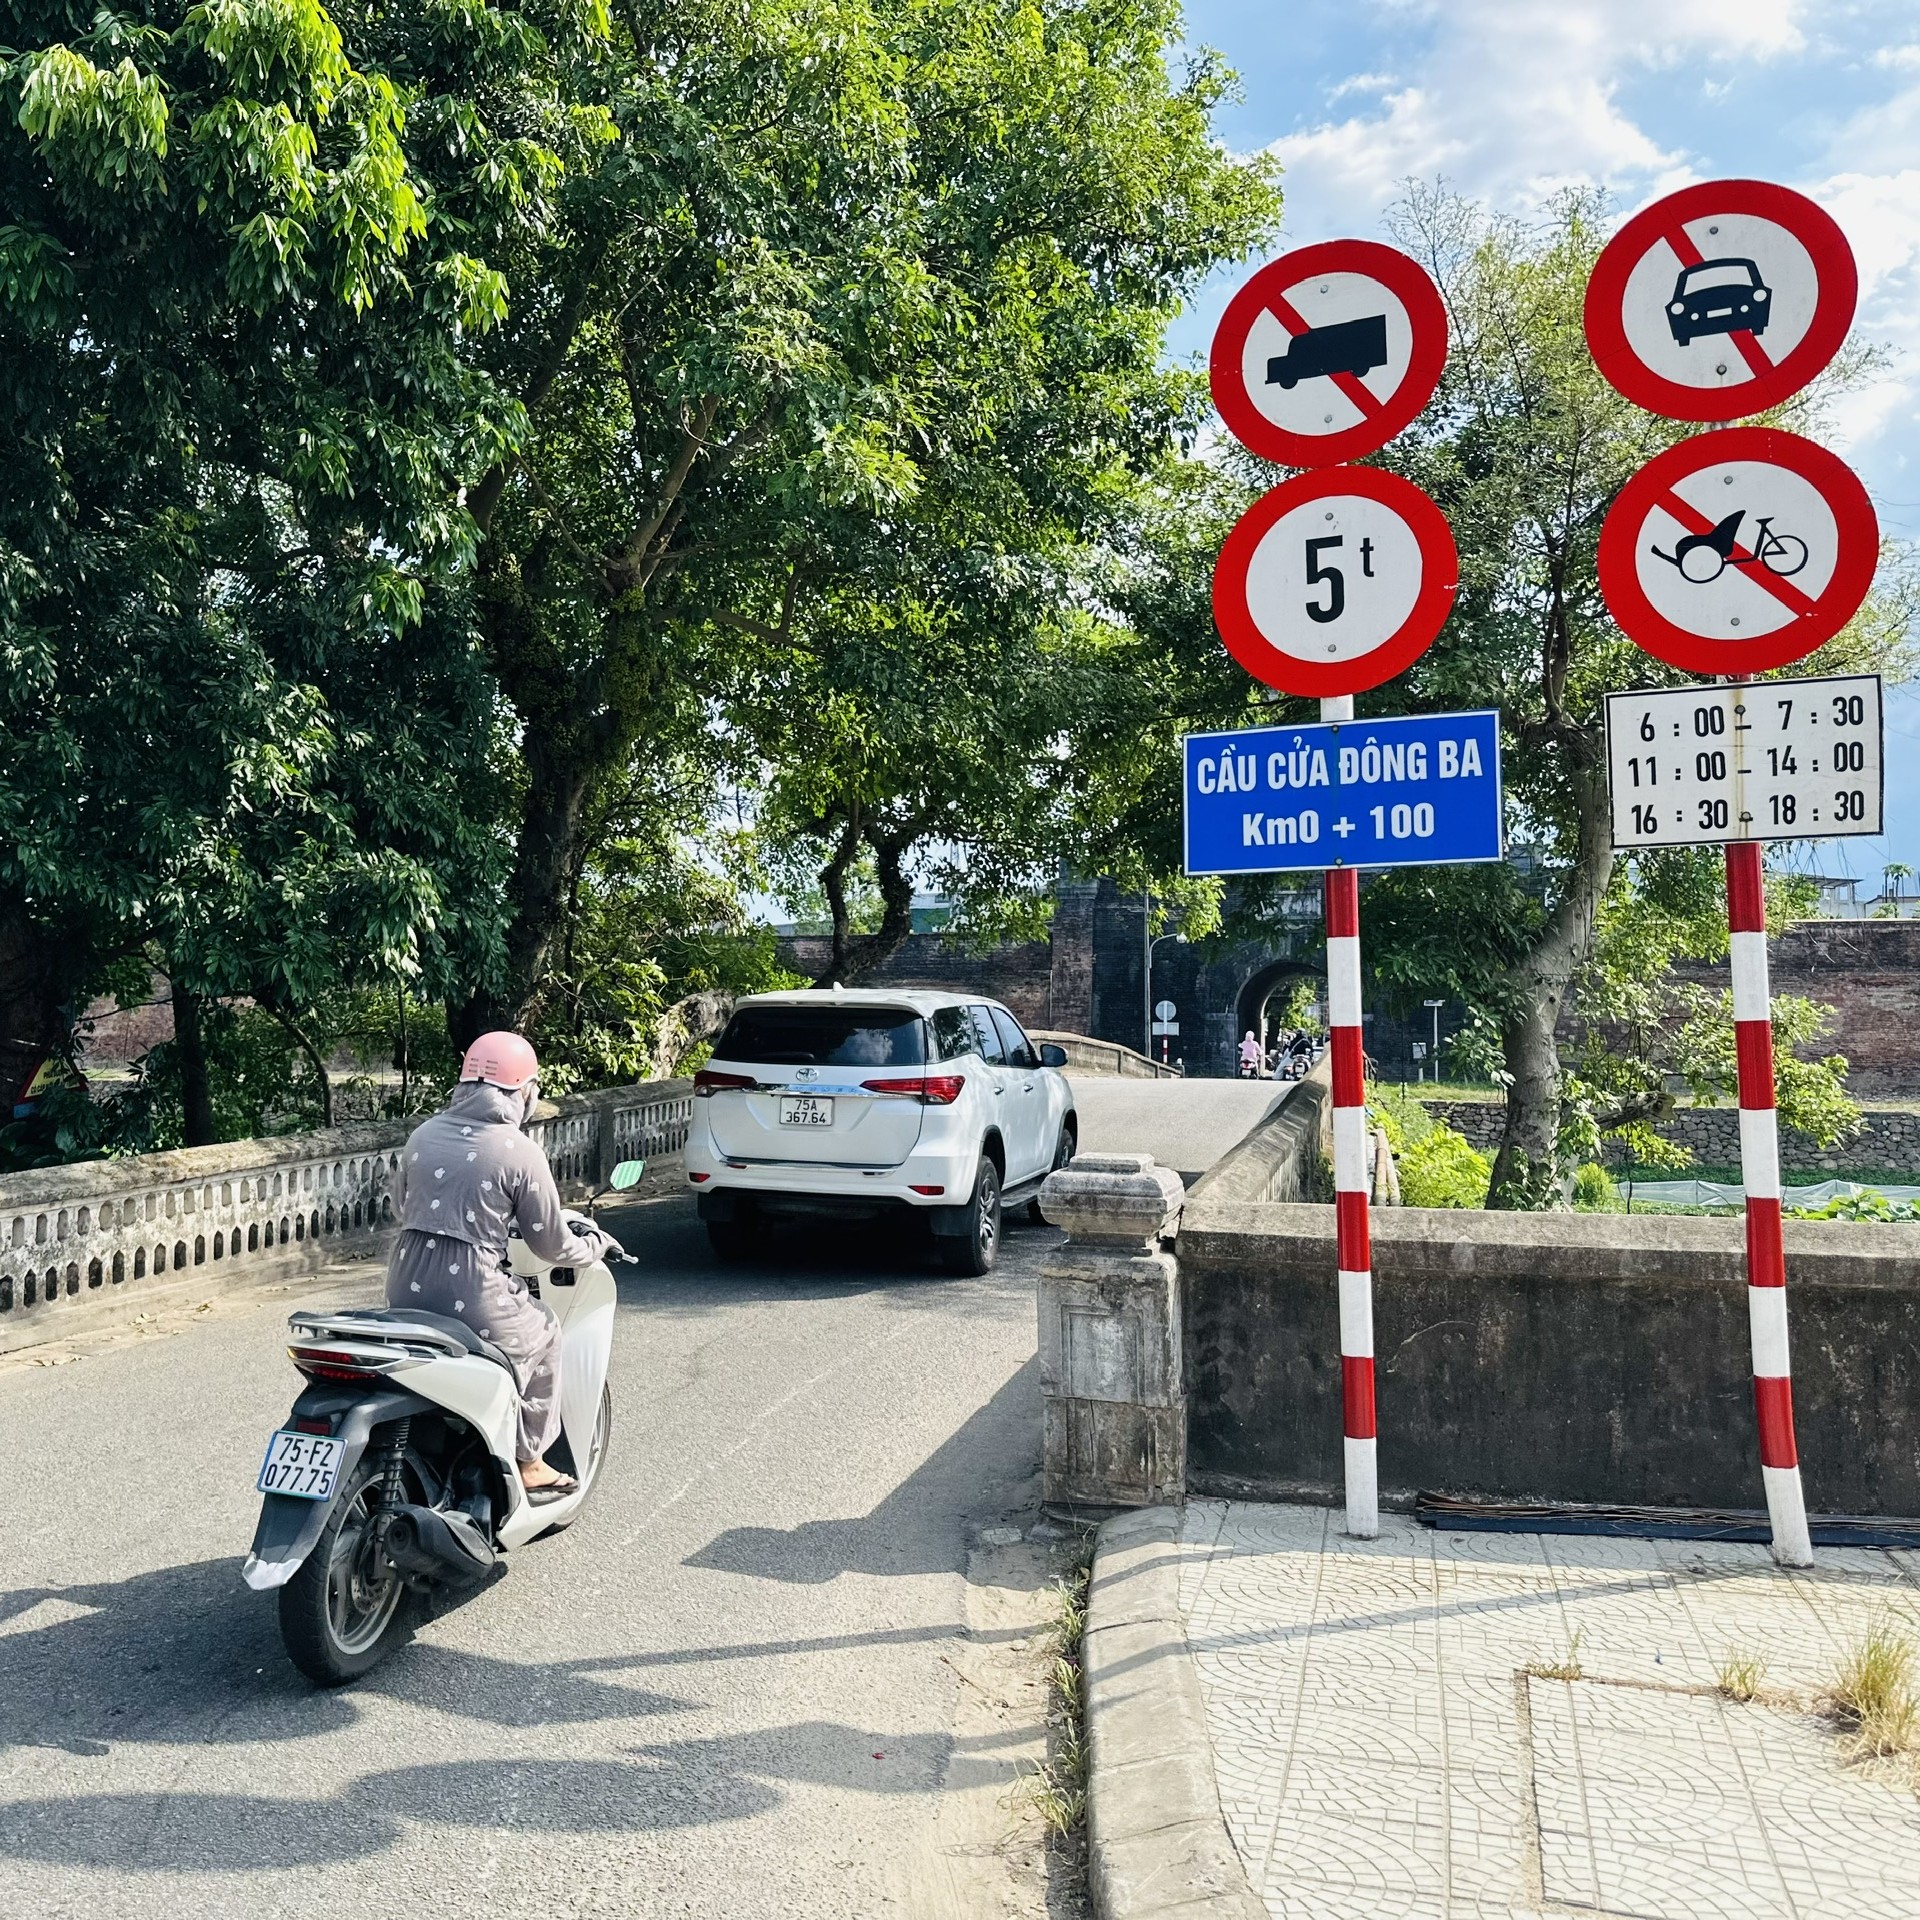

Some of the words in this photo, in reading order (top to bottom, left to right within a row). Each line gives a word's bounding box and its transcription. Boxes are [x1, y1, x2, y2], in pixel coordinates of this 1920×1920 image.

[1305, 534, 1345, 624] 5
[1359, 537, 1375, 577] t
[1197, 743, 1256, 795] CẦU
[1267, 736, 1330, 788] CỬA
[1338, 736, 1428, 785] ĐÔNG
[1438, 737, 1483, 779] BA
[1242, 809, 1319, 847] Km0
[1369, 802, 1435, 840] 100
[785, 1111, 826, 1124] 367.64
[795, 1099, 817, 1111] 75A
[279, 1436, 334, 1467] 75-F2
[264, 1463, 333, 1495] 077.75
